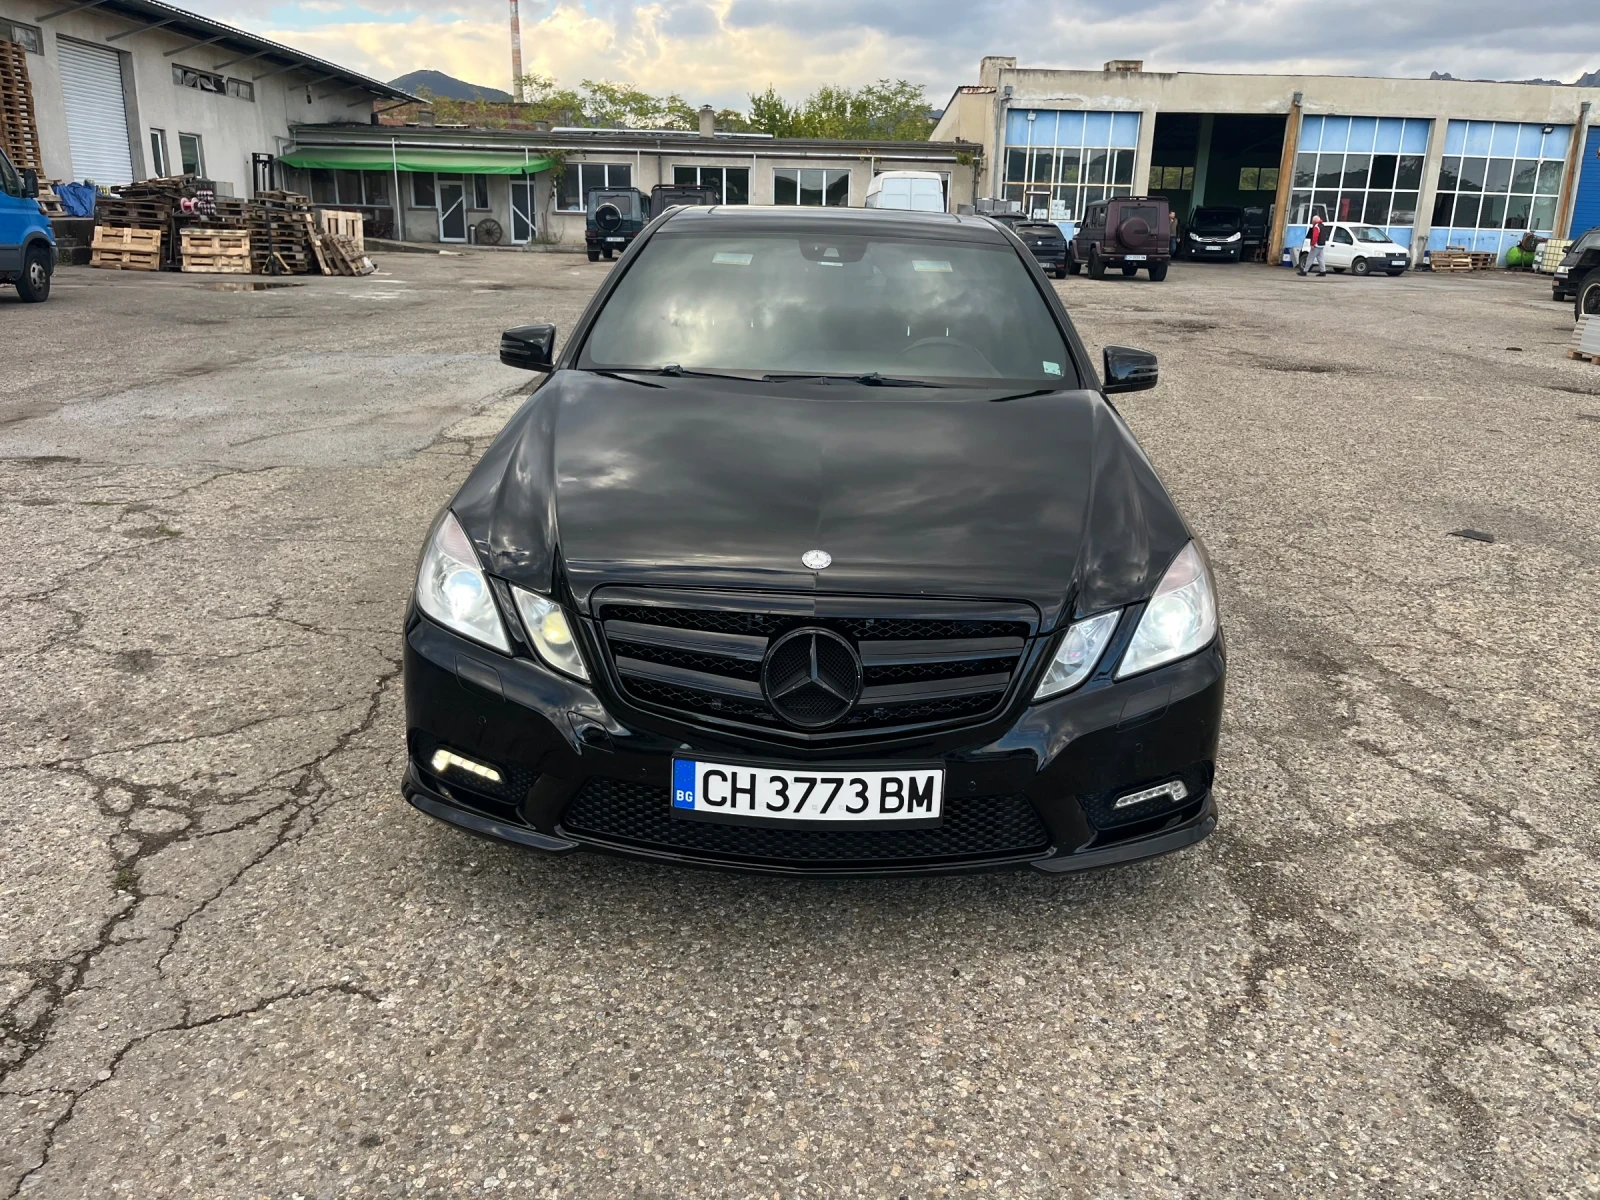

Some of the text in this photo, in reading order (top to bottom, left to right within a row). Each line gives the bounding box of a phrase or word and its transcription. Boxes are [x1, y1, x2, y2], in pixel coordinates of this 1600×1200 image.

[676, 789, 693, 803] BG
[702, 769, 935, 814] CH 3773 BM
